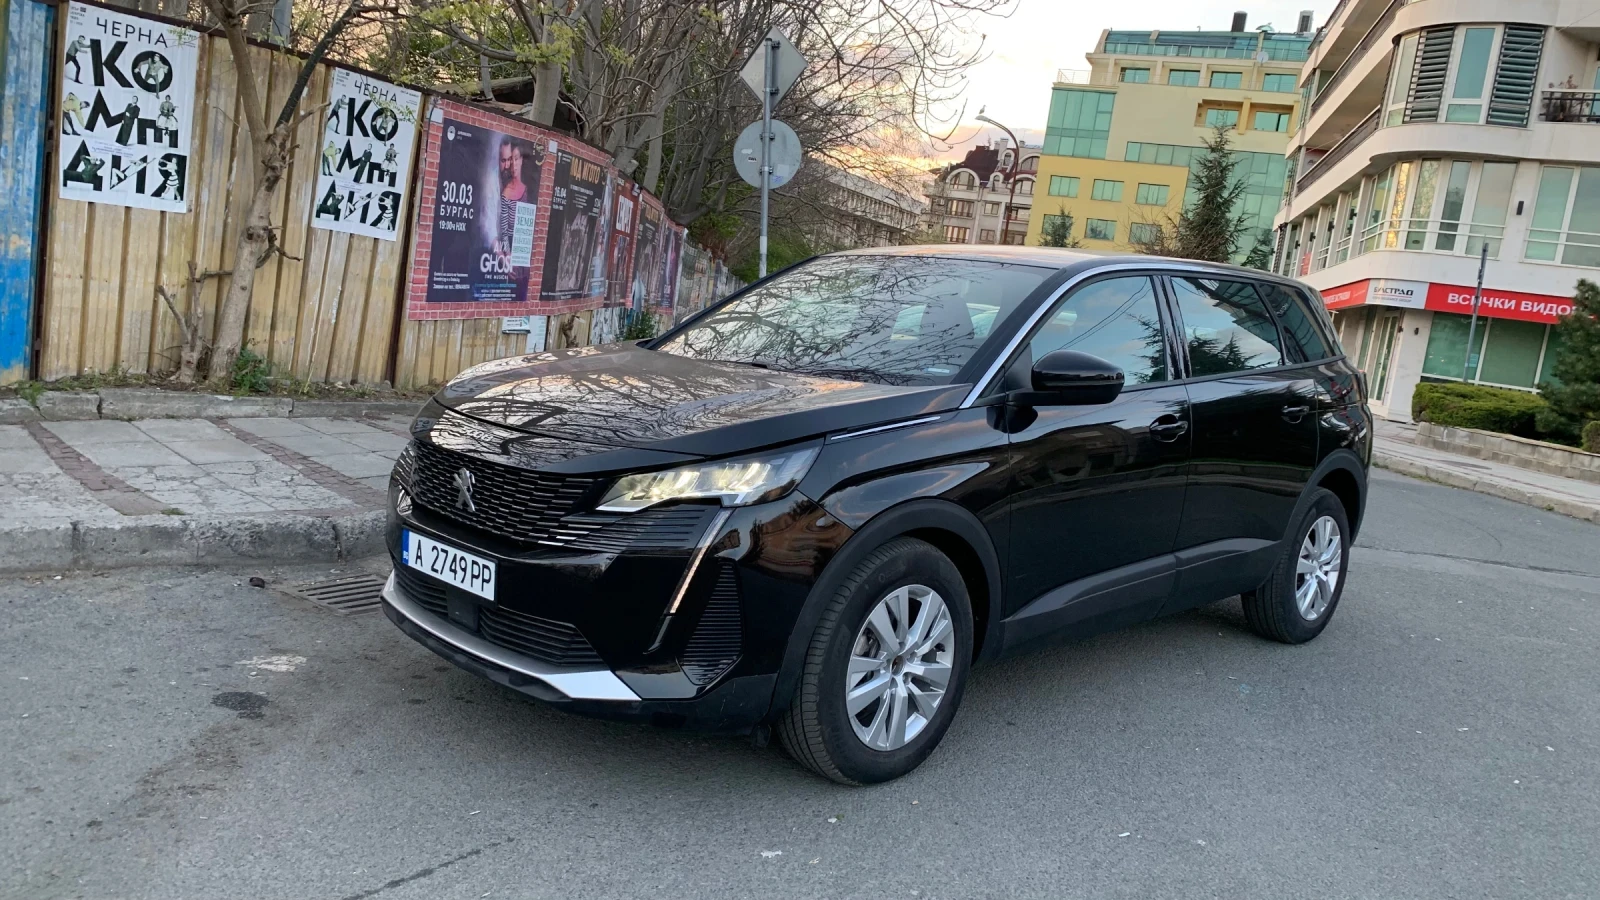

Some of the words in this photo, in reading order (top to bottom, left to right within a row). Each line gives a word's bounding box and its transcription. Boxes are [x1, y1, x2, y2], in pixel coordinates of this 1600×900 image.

[96, 17, 168, 48] ЧЕРНА
[89, 38, 174, 94] КО
[354, 80, 398, 105] ЧЕРНА
[345, 97, 399, 142] КО
[62, 139, 188, 201] ДИЯ
[315, 180, 402, 231] ДИЯ
[440, 204, 474, 220] БУРГАС
[441, 180, 473, 206] 30.03
[1447, 293, 1517, 310] ВСИЧКИ
[1520, 301, 1576, 317] ВИДО
[415, 539, 424, 568] A
[430, 545, 468, 584] 2749
[471, 559, 492, 592] PP
